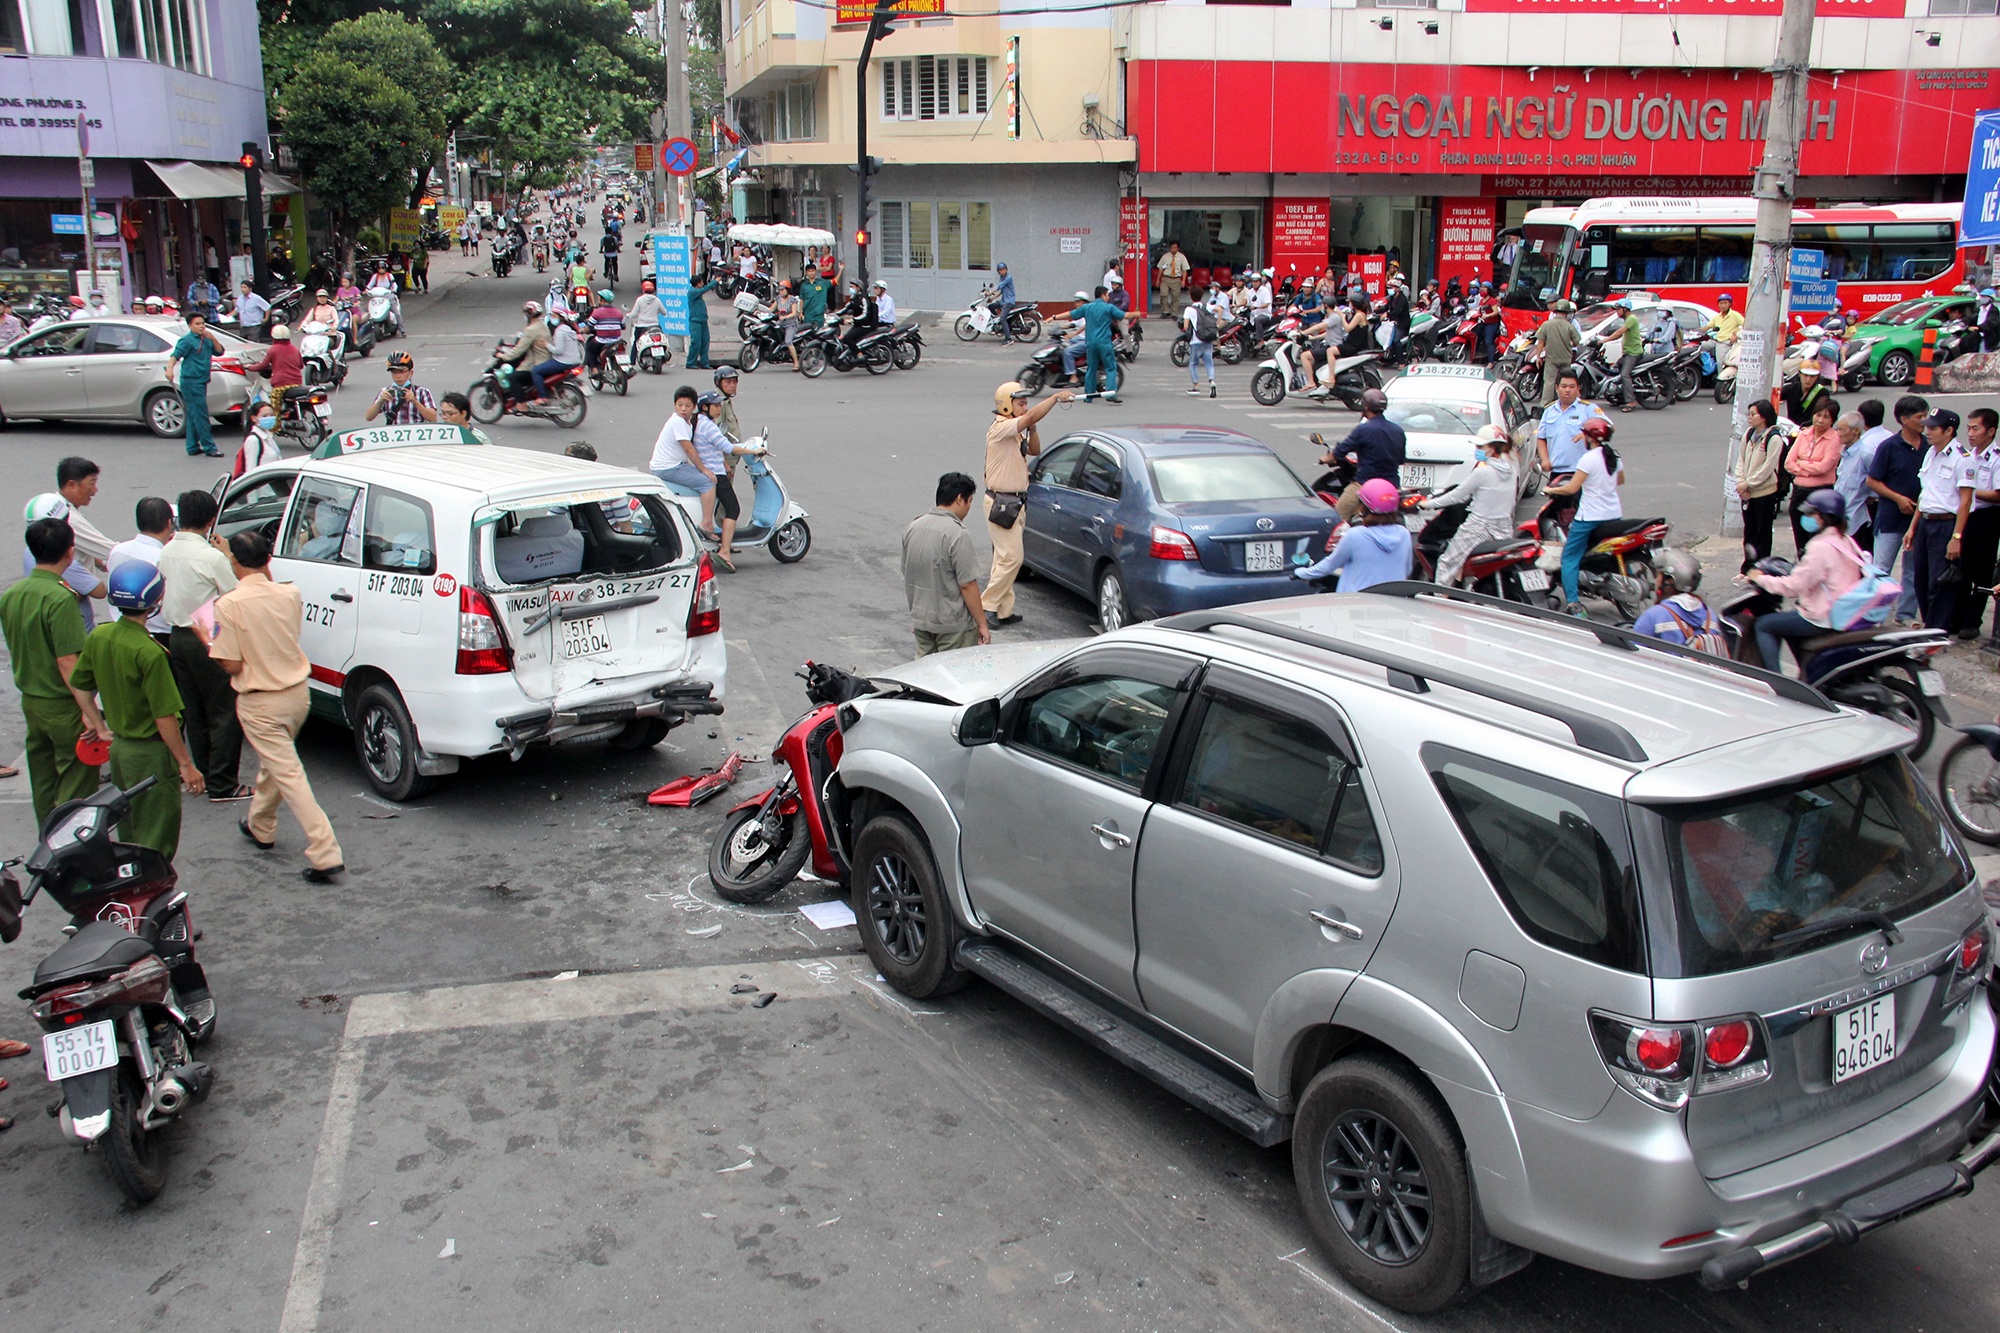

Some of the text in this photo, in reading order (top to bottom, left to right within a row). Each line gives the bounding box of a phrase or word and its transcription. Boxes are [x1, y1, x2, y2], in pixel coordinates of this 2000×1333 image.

[39, 118, 103, 128] 3995545
[1338, 84, 1837, 147] NGOẠI NGỮ DƯƠNG MH
[1335, 152, 1359, 164] 132
[1529, 178, 1543, 187] 27
[1285, 205, 1305, 213] TOEFL
[1473, 207, 1486, 215] TÂM
[1443, 227, 1492, 242] DƯƠNG MINH
[1792, 294, 1807, 305] PHAN
[1424, 366, 1482, 376] 38.27 27 27
[369, 428, 454, 444] 38.27 27 27
[1410, 467, 1427, 476] 51A
[1254, 543, 1274, 556] 51A
[1247, 556, 1282, 570] 727.59
[368, 574, 388, 592] 51F
[434, 576, 455, 594] 8198
[596, 582, 642, 599] 38.27
[645, 577, 666, 592] 27
[670, 574, 691, 588] 27
[306, 602, 336, 628] 27 27
[572, 618, 594, 638] 51F
[566, 634, 610, 657] 203.04
[1850, 1001, 1881, 1040] 51F
[54, 1026, 104, 1054] 55-Y4
[58, 1045, 108, 1075] 0007
[1837, 1028, 1893, 1077] 946.04
